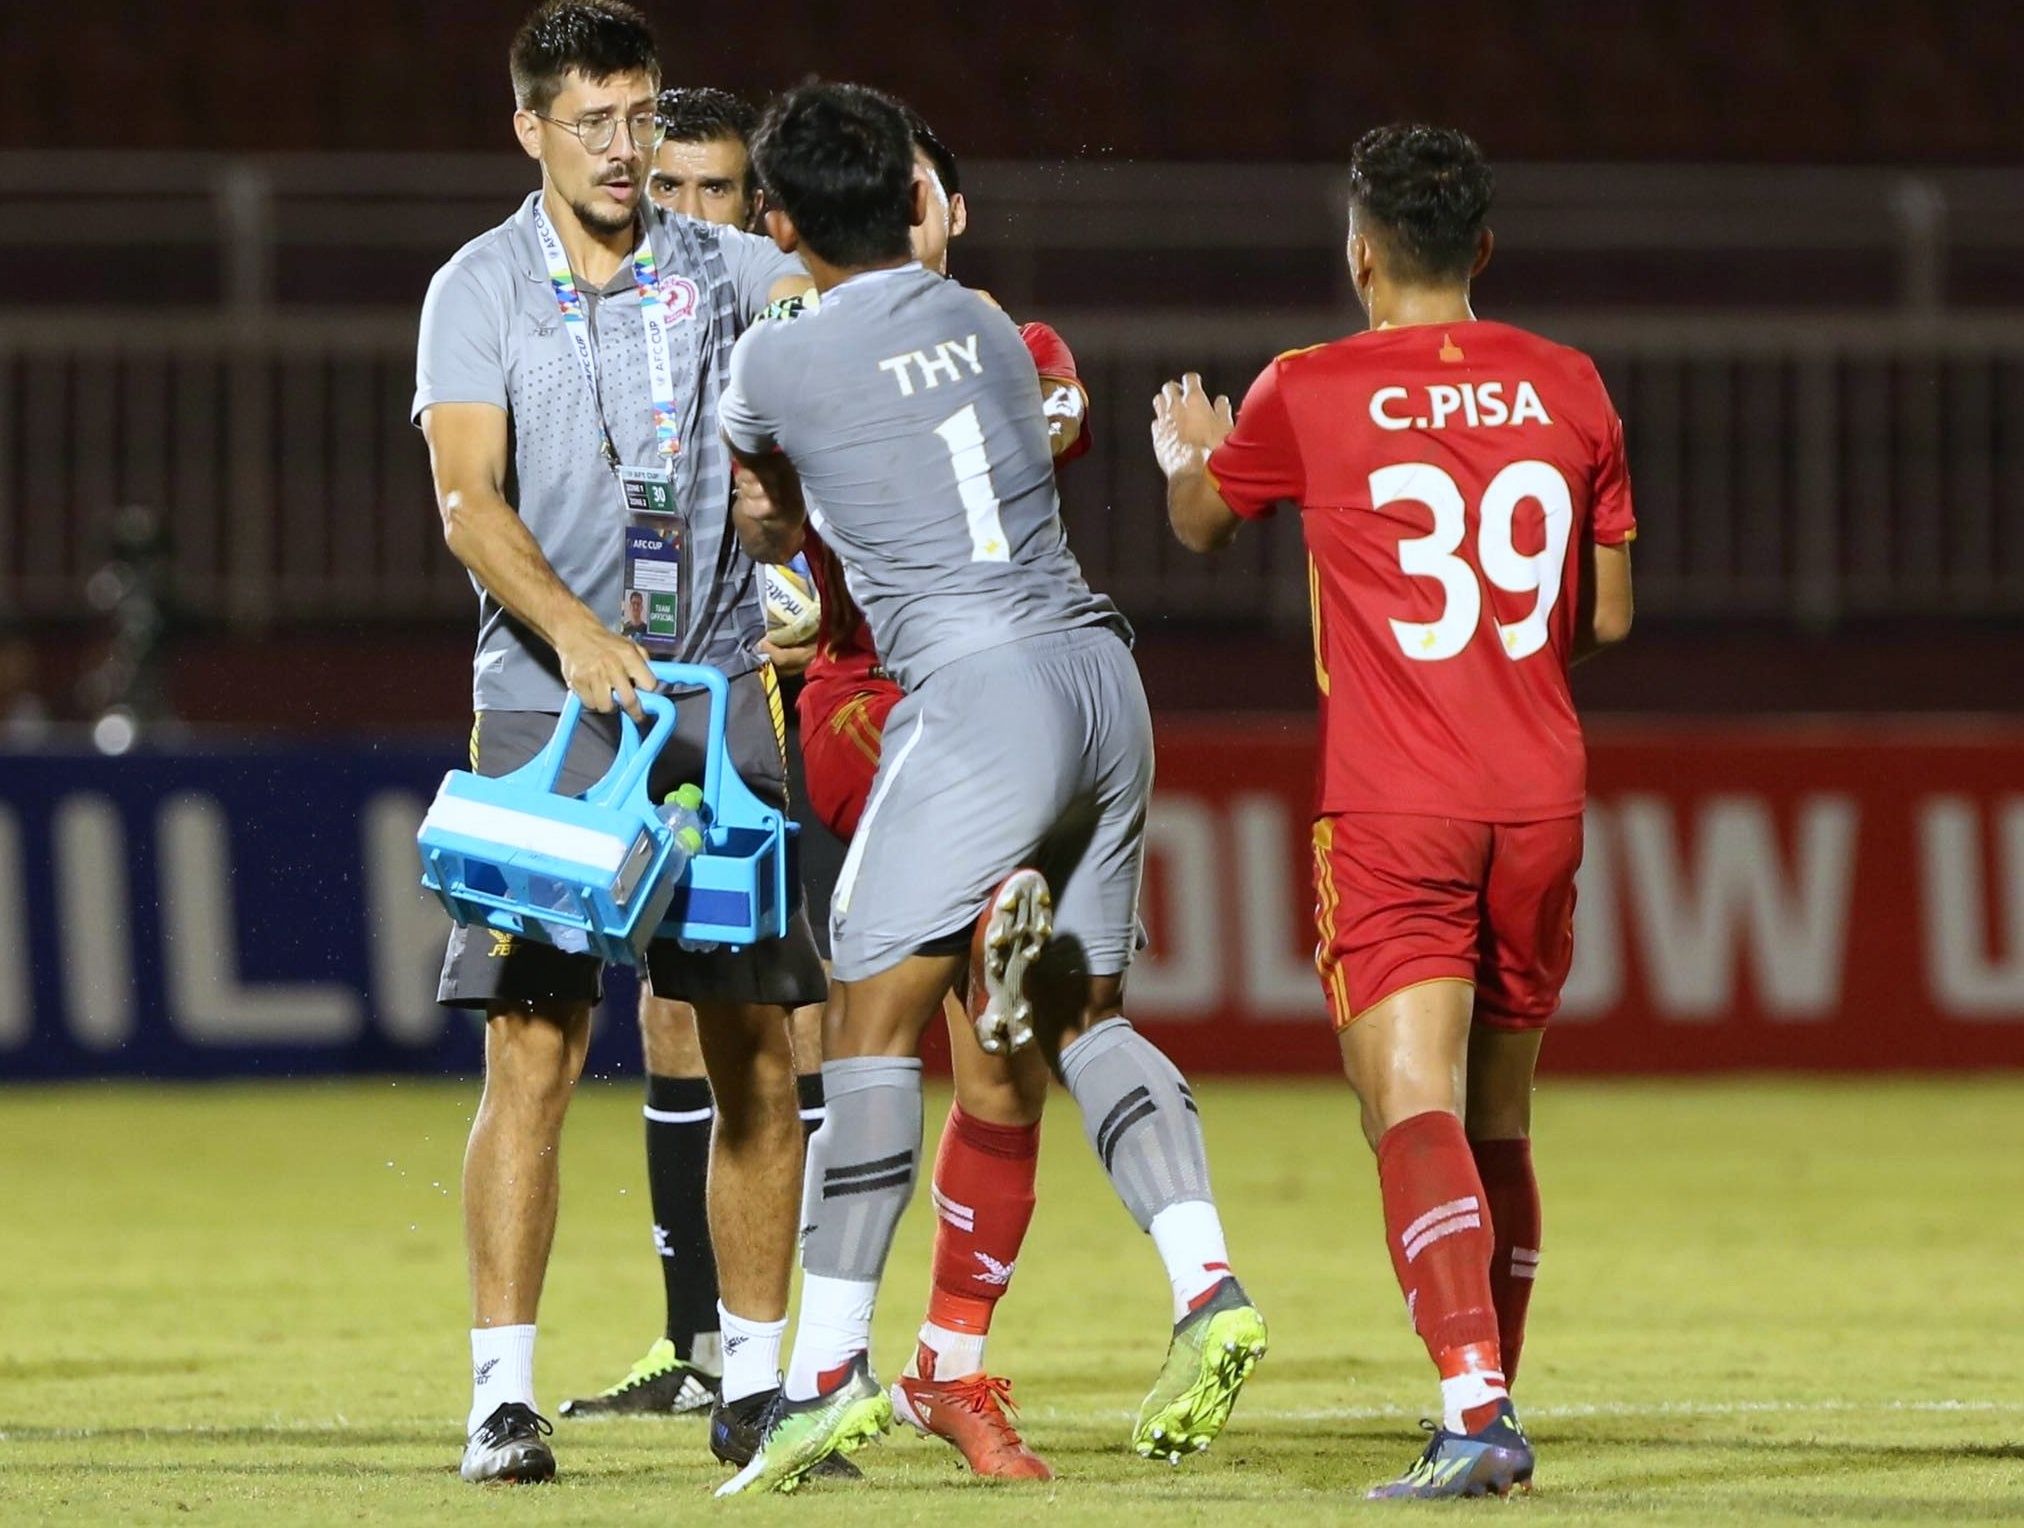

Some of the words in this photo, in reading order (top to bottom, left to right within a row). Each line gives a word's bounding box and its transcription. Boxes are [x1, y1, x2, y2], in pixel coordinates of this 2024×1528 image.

[650, 320, 662, 344] CUP
[575, 334, 588, 357] CUP
[652, 345, 665, 371] AFC
[879, 334, 983, 396] THY
[1369, 381, 1554, 430] C.PISA
[651, 485, 667, 503] 30
[932, 402, 1011, 563] 1
[633, 539, 648, 549] AFC
[648, 541, 663, 551] CUP
[1368, 460, 1573, 661] 39
[650, 612, 676, 623] OFFICIAL
[655, 604, 671, 613] TEAM
